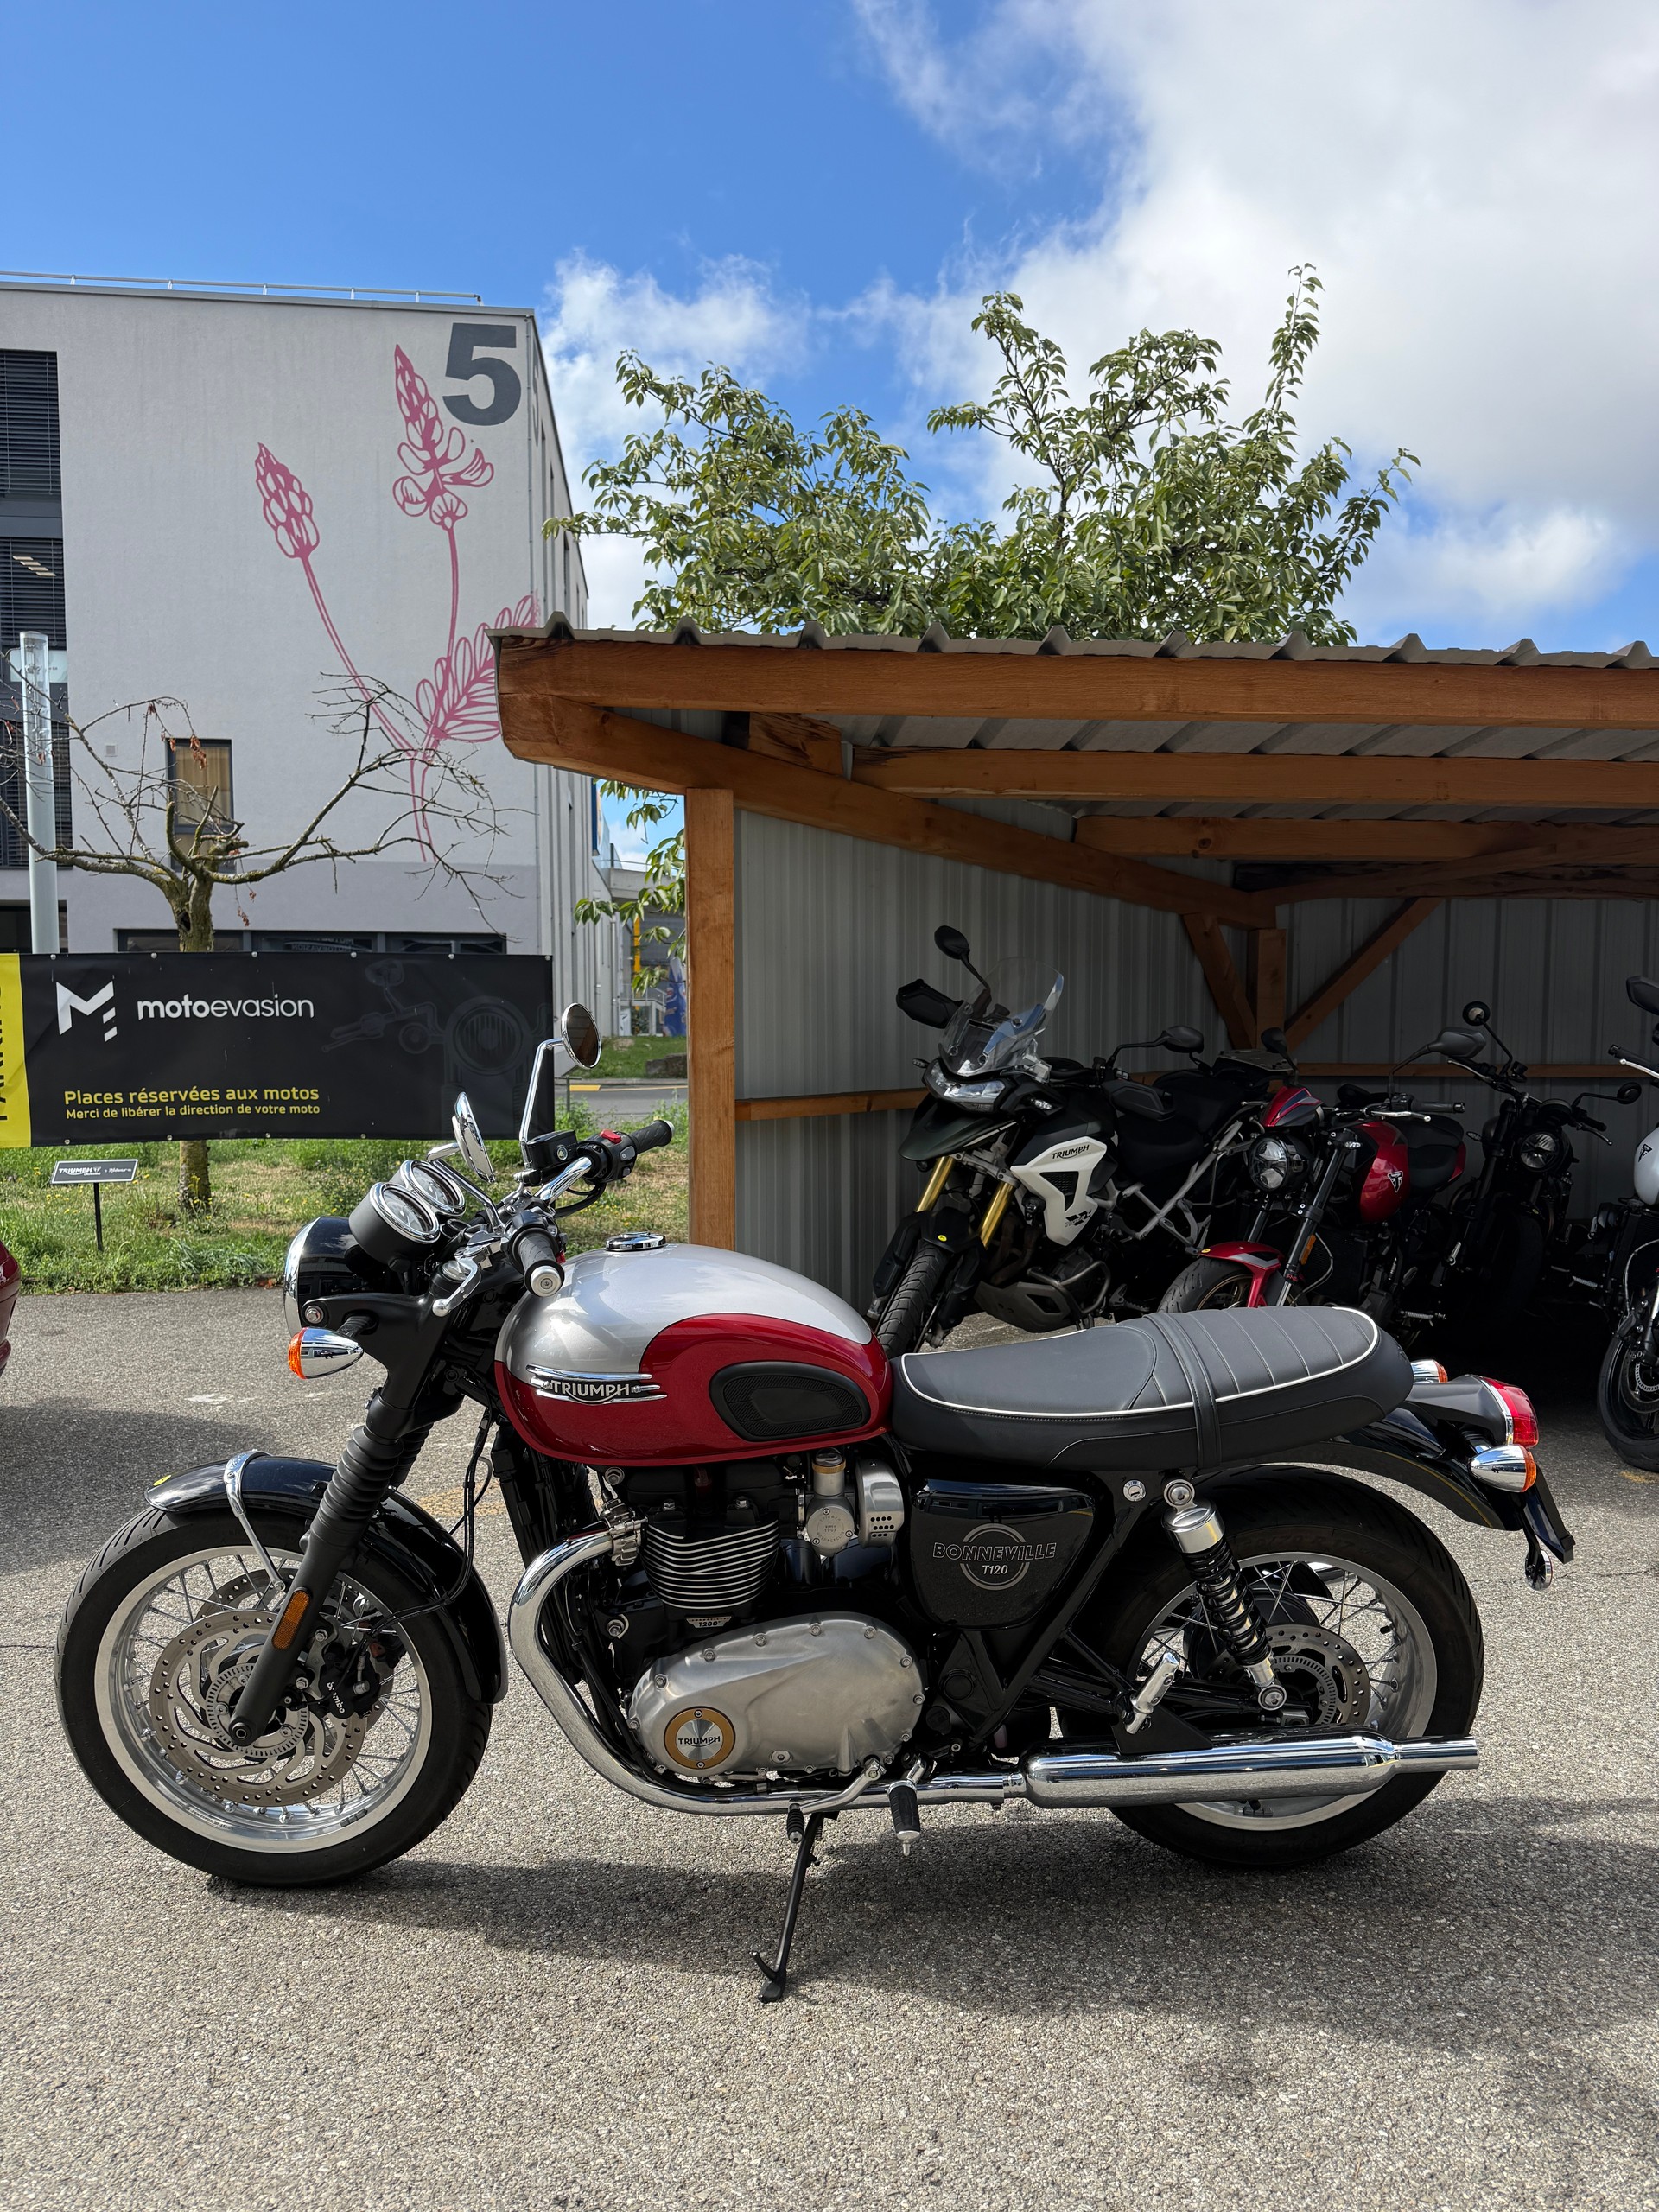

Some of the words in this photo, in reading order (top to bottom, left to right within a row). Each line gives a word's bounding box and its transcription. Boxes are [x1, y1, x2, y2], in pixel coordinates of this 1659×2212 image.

[442, 322, 522, 426] 5
[137, 993, 315, 1021] motoevasion
[64, 1090, 124, 1105] Places
[129, 1085, 220, 1103] réservées
[226, 1089, 258, 1101] aux
[264, 1086, 320, 1101] motos
[66, 1108, 99, 1119] Merci
[103, 1107, 118, 1118] de
[121, 1106, 162, 1117] libérer
[165, 1104, 176, 1116] la
[180, 1103, 234, 1116] direction
[237, 1103, 252, 1115] de
[255, 1104, 286, 1115] votre
[289, 1104, 321, 1115] moto
[1052, 1145, 1090, 1159] TRIUMPH
[58, 1166, 93, 1176] TRIUMPH
[550, 1380, 631, 1403] TRIUMPH
[932, 1541, 1057, 1561] BONNEVILLE
[982, 1565, 1008, 1575] T120
[677, 1735, 721, 1748] TRIUMPH
